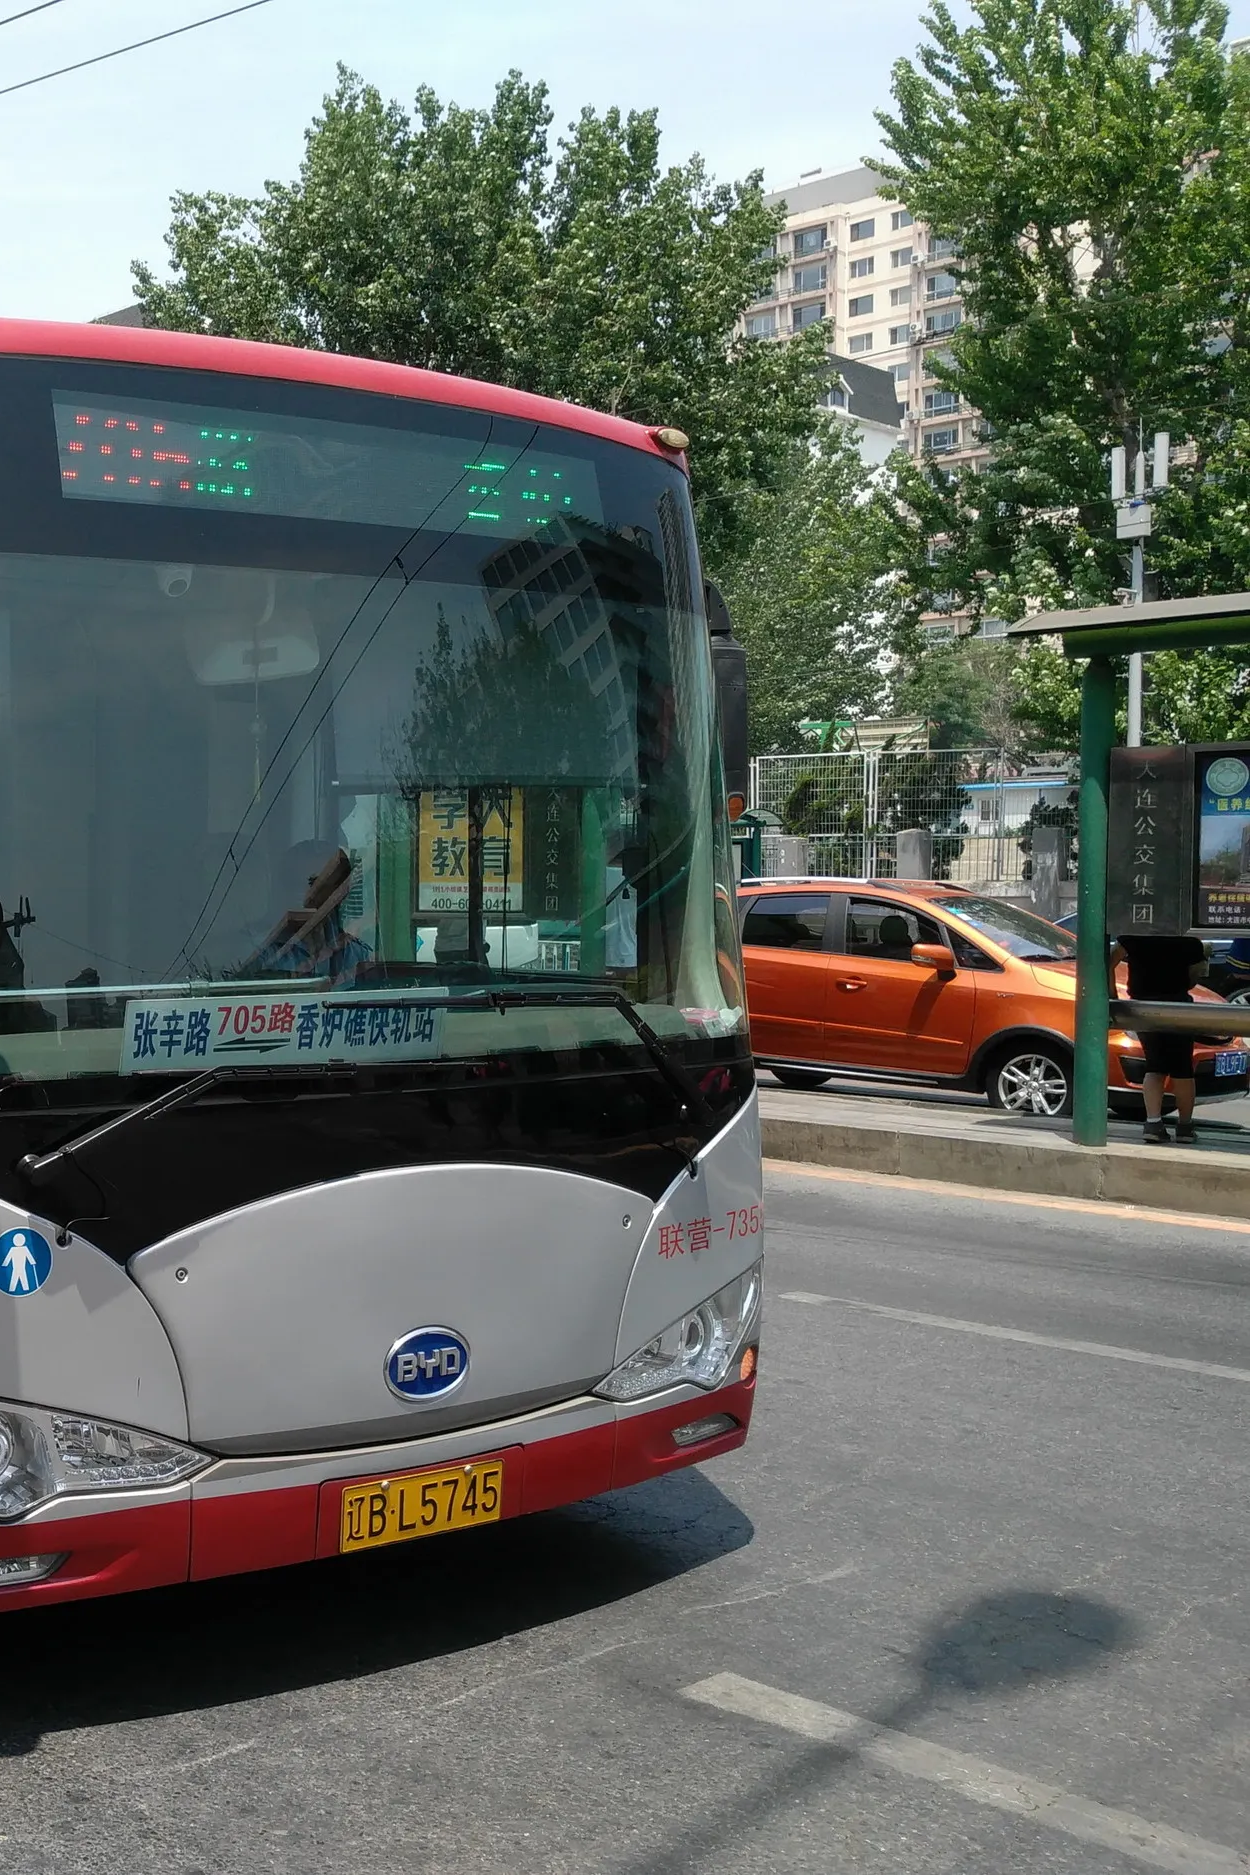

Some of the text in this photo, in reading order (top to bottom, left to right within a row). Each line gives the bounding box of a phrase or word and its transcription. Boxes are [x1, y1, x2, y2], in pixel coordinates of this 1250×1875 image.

[432, 836, 511, 877] 教育
[1133, 760, 1157, 924] 大连公交集团
[132, 1002, 435, 1059] 张辛路 705路 香炉礁快轨站
[397, 1346, 460, 1383] BYD
